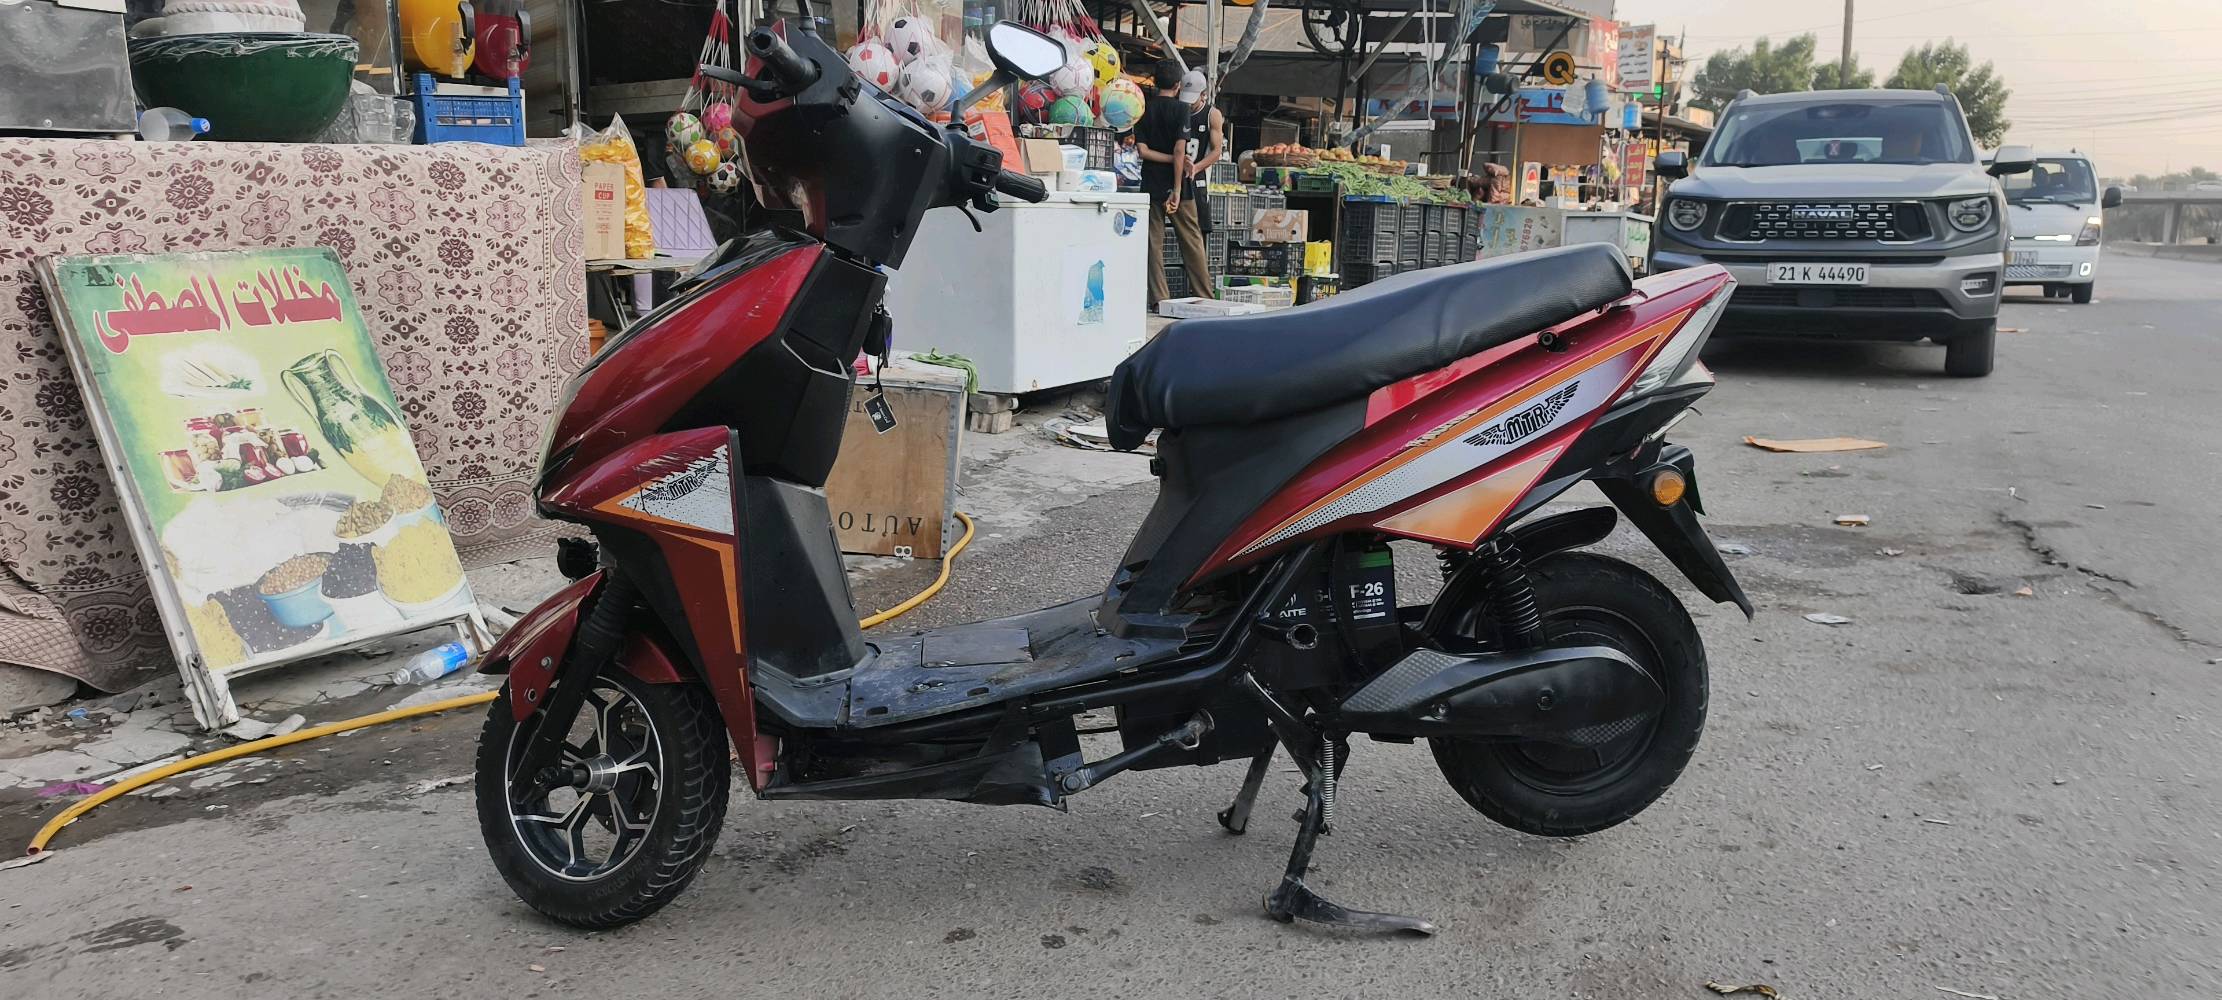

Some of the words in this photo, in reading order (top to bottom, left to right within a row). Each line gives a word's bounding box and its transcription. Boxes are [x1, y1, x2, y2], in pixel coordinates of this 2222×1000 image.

[594, 182, 614, 190] PAPER
[1795, 209, 1850, 219] HAVAL
[1778, 266, 1796, 281] 21
[1802, 266, 1812, 281] K
[1818, 266, 1865, 282] 44490
[232, 264, 342, 327] مخللات
[93, 271, 231, 355] المصطفى
[838, 511, 923, 537] AUTO
